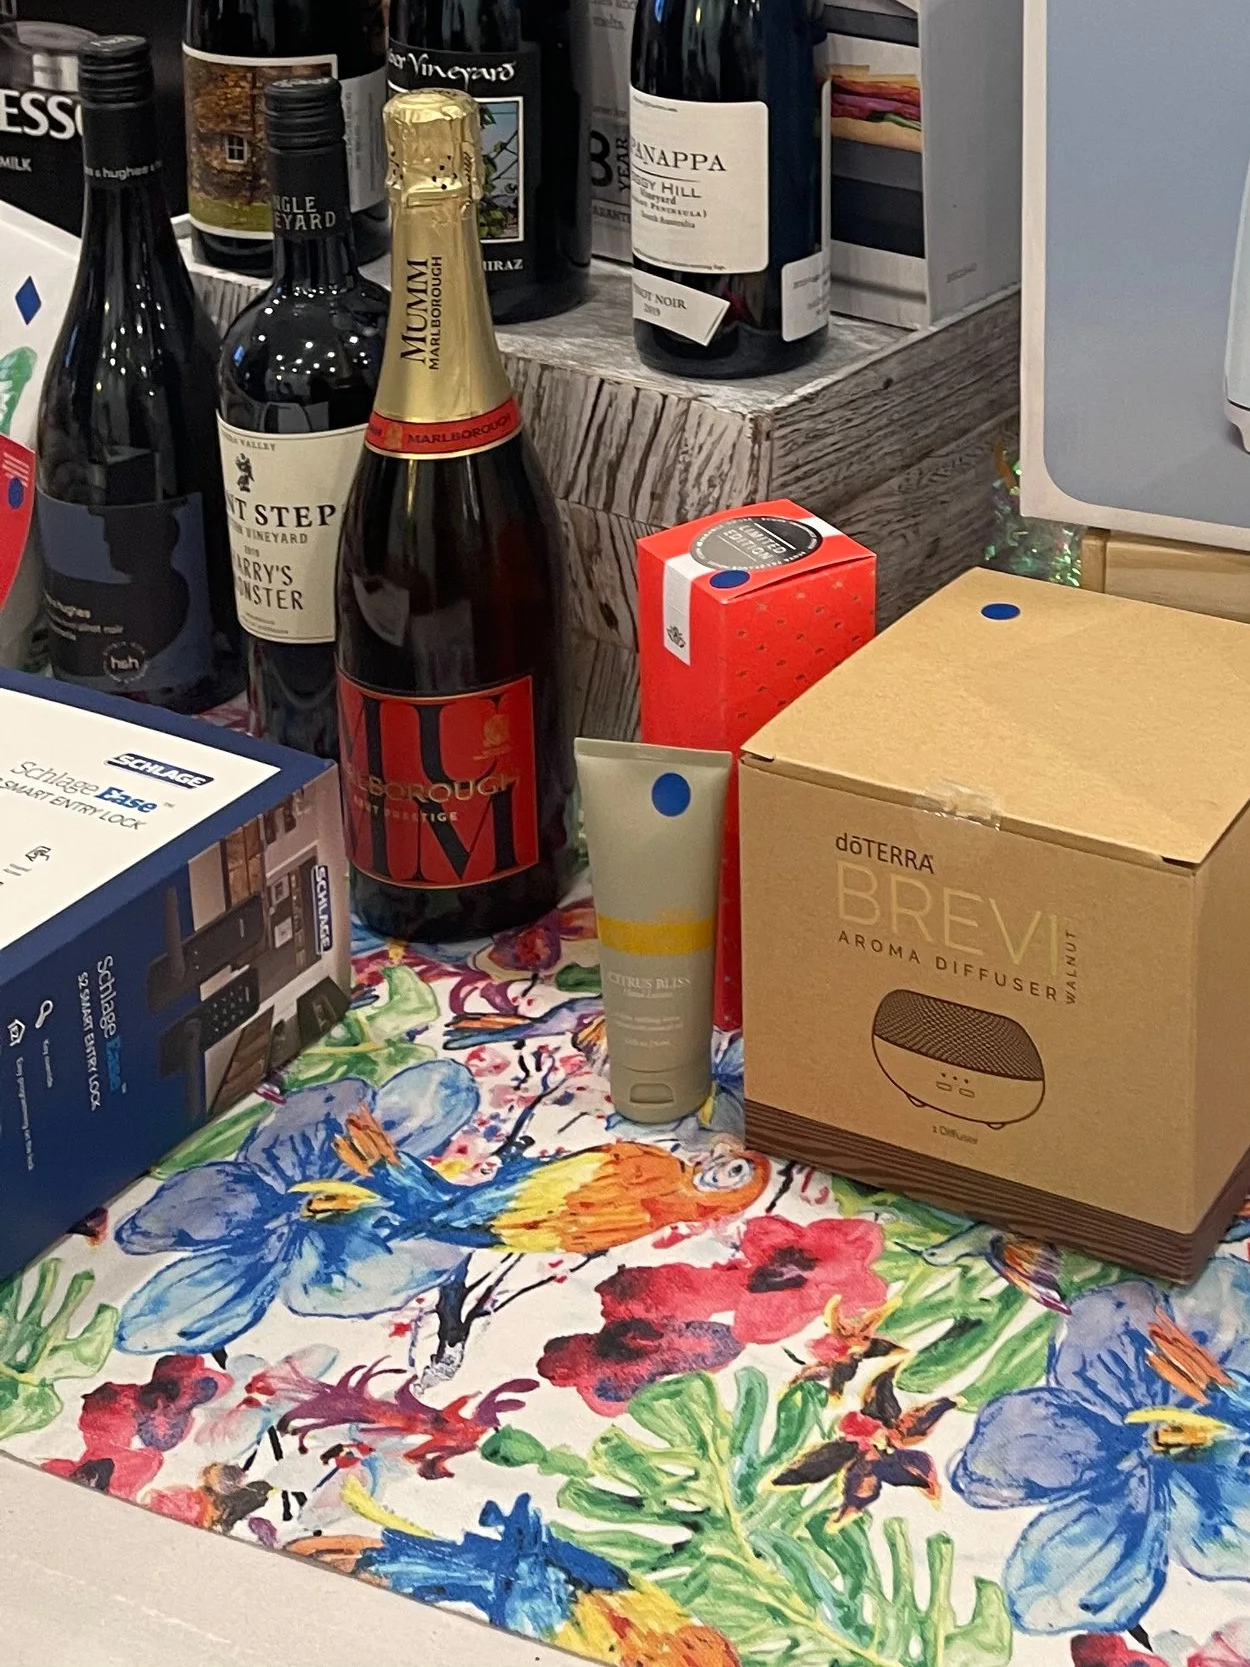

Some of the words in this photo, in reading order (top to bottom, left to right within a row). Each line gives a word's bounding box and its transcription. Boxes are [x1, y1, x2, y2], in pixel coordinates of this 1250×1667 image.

[428, 255, 442, 370] MARLBOROUGH
[655, 293, 687, 310] NOIR
[245, 527, 308, 544] VINEYARD
[722, 529, 775, 561] EDITION
[738, 524, 787, 555] LIMITED
[10, 761, 101, 795] Schlage
[94, 786, 157, 813] Ease
[112, 754, 207, 786] SCHLAGE
[4, 780, 54, 801] SMART
[49, 796, 104, 816] ENTRY
[98, 811, 147, 830] LOCK
[314, 865, 331, 952] SCHLAGE
[837, 860, 1058, 976] BREVI
[838, 930, 921, 965] AROMA
[935, 956, 1058, 1003] DIFFUSER
[1065, 930, 1079, 1005] WALNUT
[80, 989, 95, 1031] SMART
[97, 956, 118, 1039] Schlage
[85, 1031, 98, 1074] ENTRY
[88, 1073, 101, 1111] LOCK
